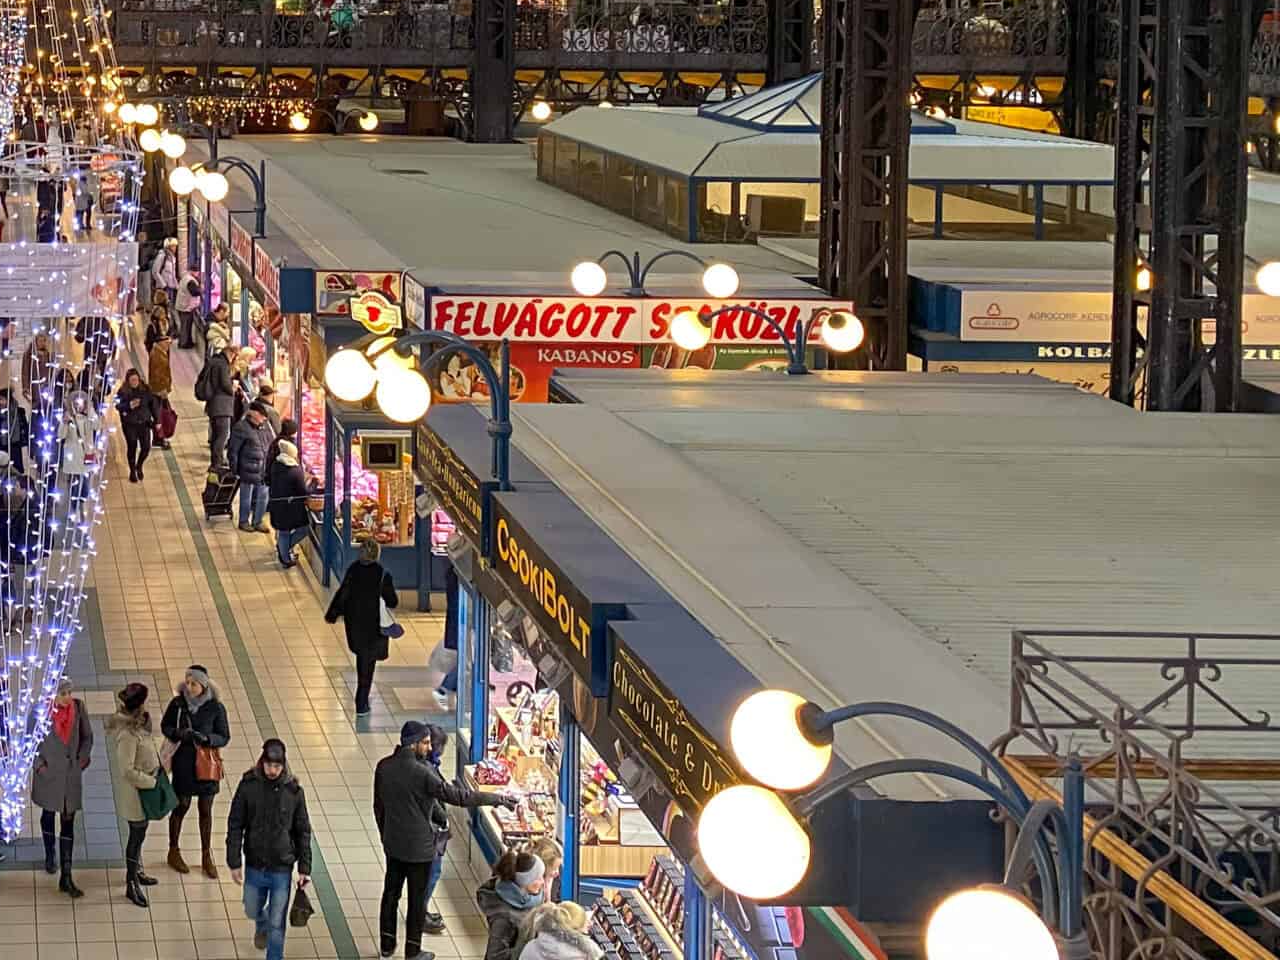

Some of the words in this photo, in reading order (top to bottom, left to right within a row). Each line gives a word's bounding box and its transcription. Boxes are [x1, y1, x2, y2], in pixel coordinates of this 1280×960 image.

[434, 299, 636, 338] FELVÁGOTT
[538, 348, 634, 363] KABANOS
[613, 661, 678, 754] Chocolate
[685, 743, 695, 772] &
